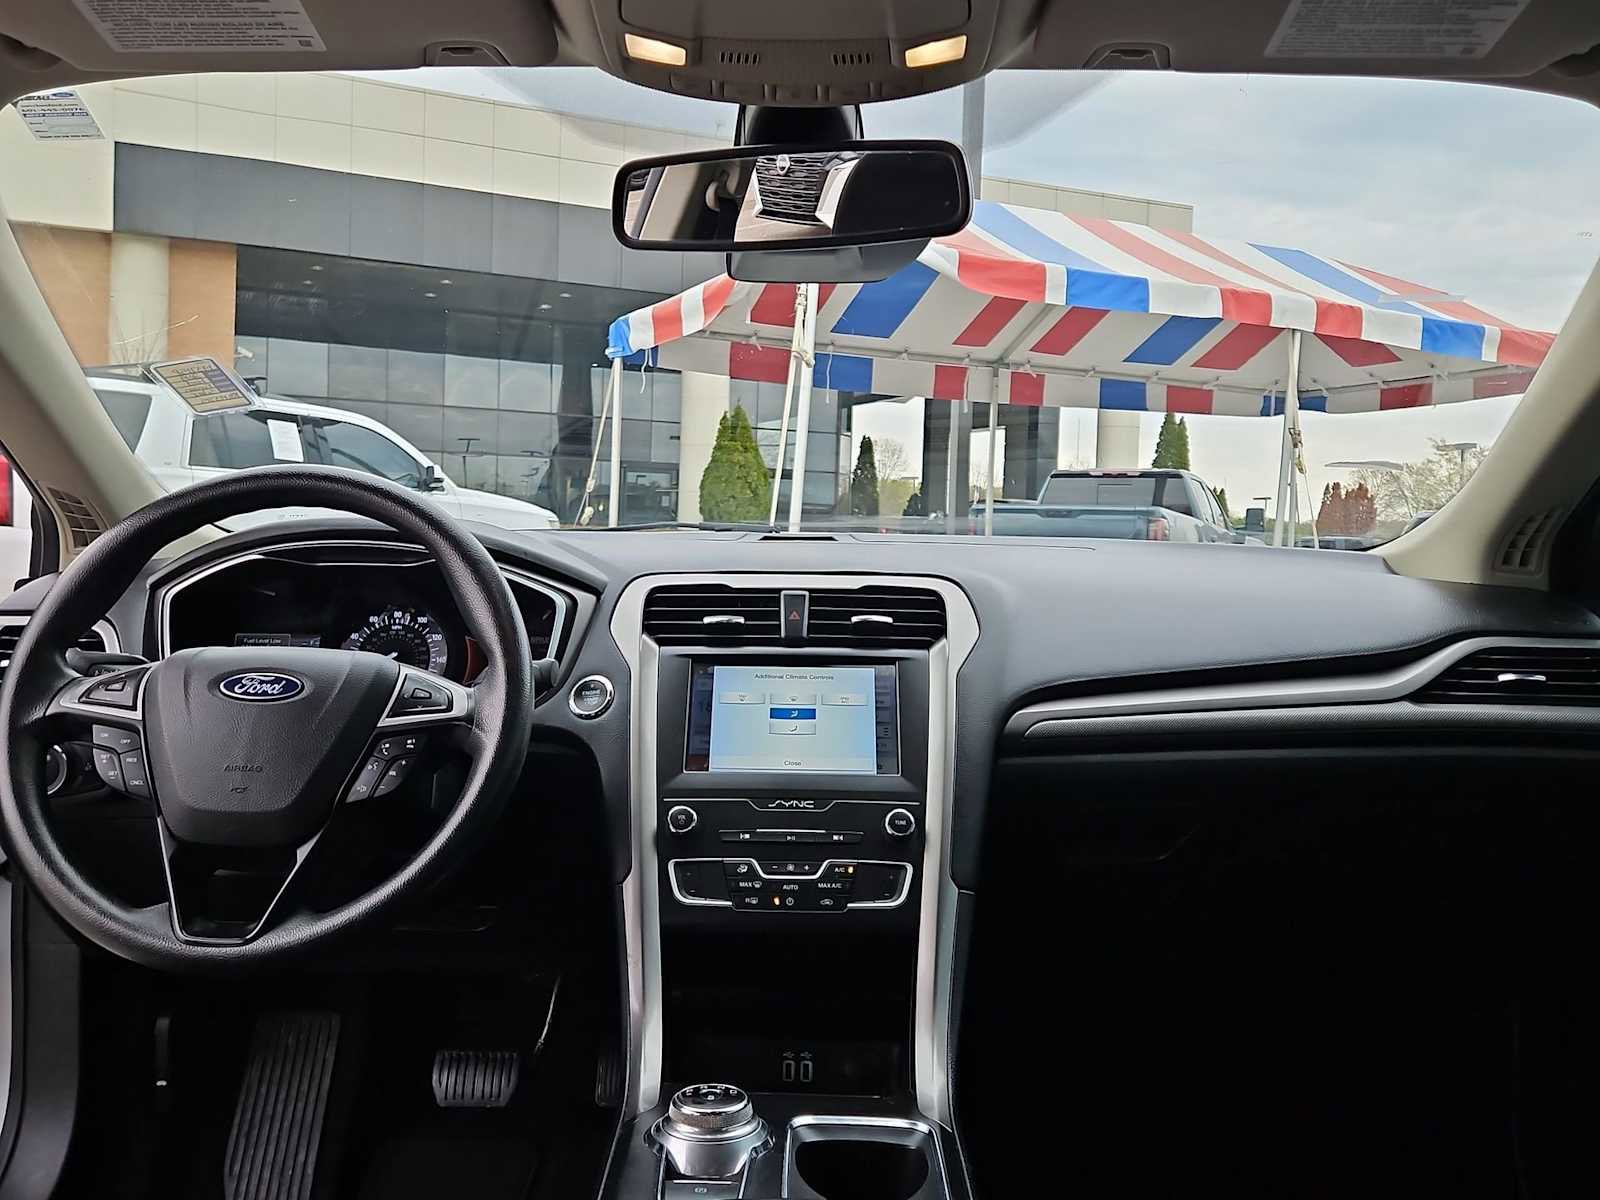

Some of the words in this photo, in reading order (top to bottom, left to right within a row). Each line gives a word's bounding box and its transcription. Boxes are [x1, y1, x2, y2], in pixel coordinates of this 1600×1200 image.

[417, 616, 428, 624] 100
[350, 632, 359, 640] 40
[235, 675, 285, 694] Ford
[223, 764, 264, 773] AIRBAG
[767, 800, 815, 808] SYNC
